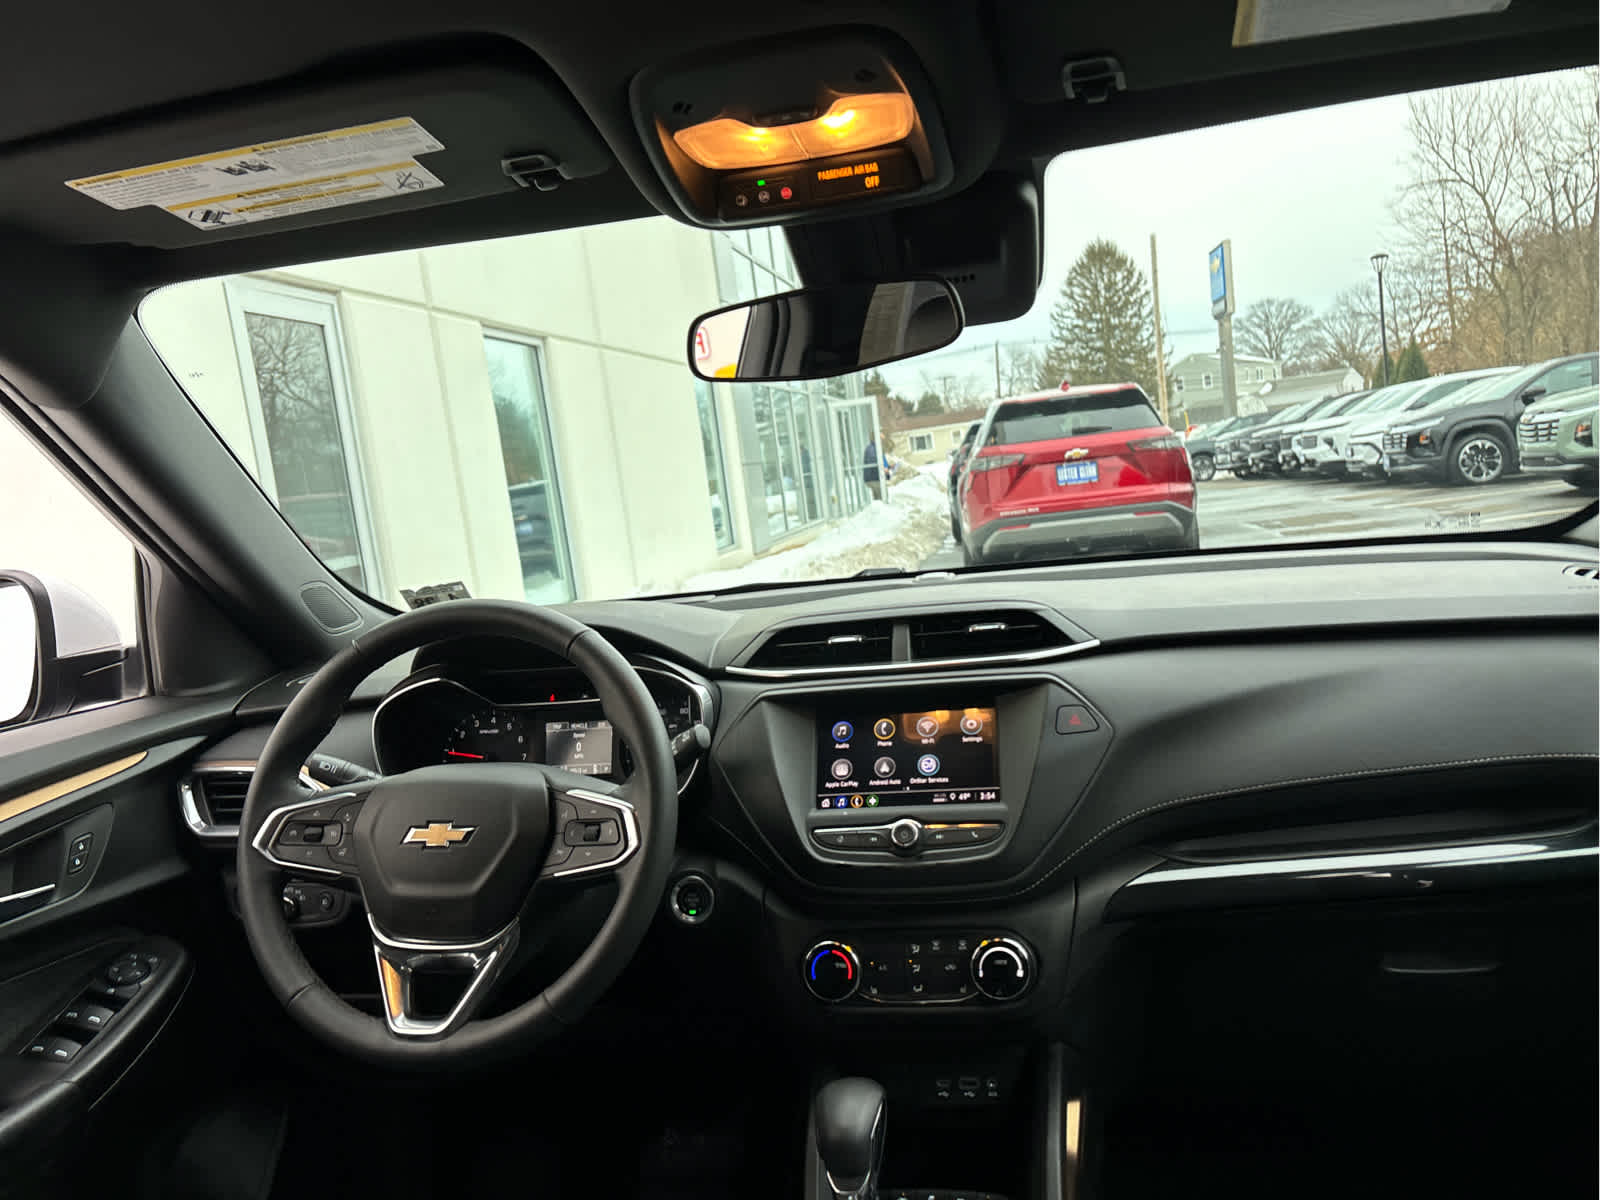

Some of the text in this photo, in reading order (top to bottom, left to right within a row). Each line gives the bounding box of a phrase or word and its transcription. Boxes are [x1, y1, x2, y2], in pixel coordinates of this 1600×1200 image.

[817, 166, 853, 181] PASSENGER
[865, 176, 880, 188] OFF
[962, 735, 983, 743] Settings
[825, 780, 859, 789] Apple CarPlay
[980, 791, 996, 800] 3:54
